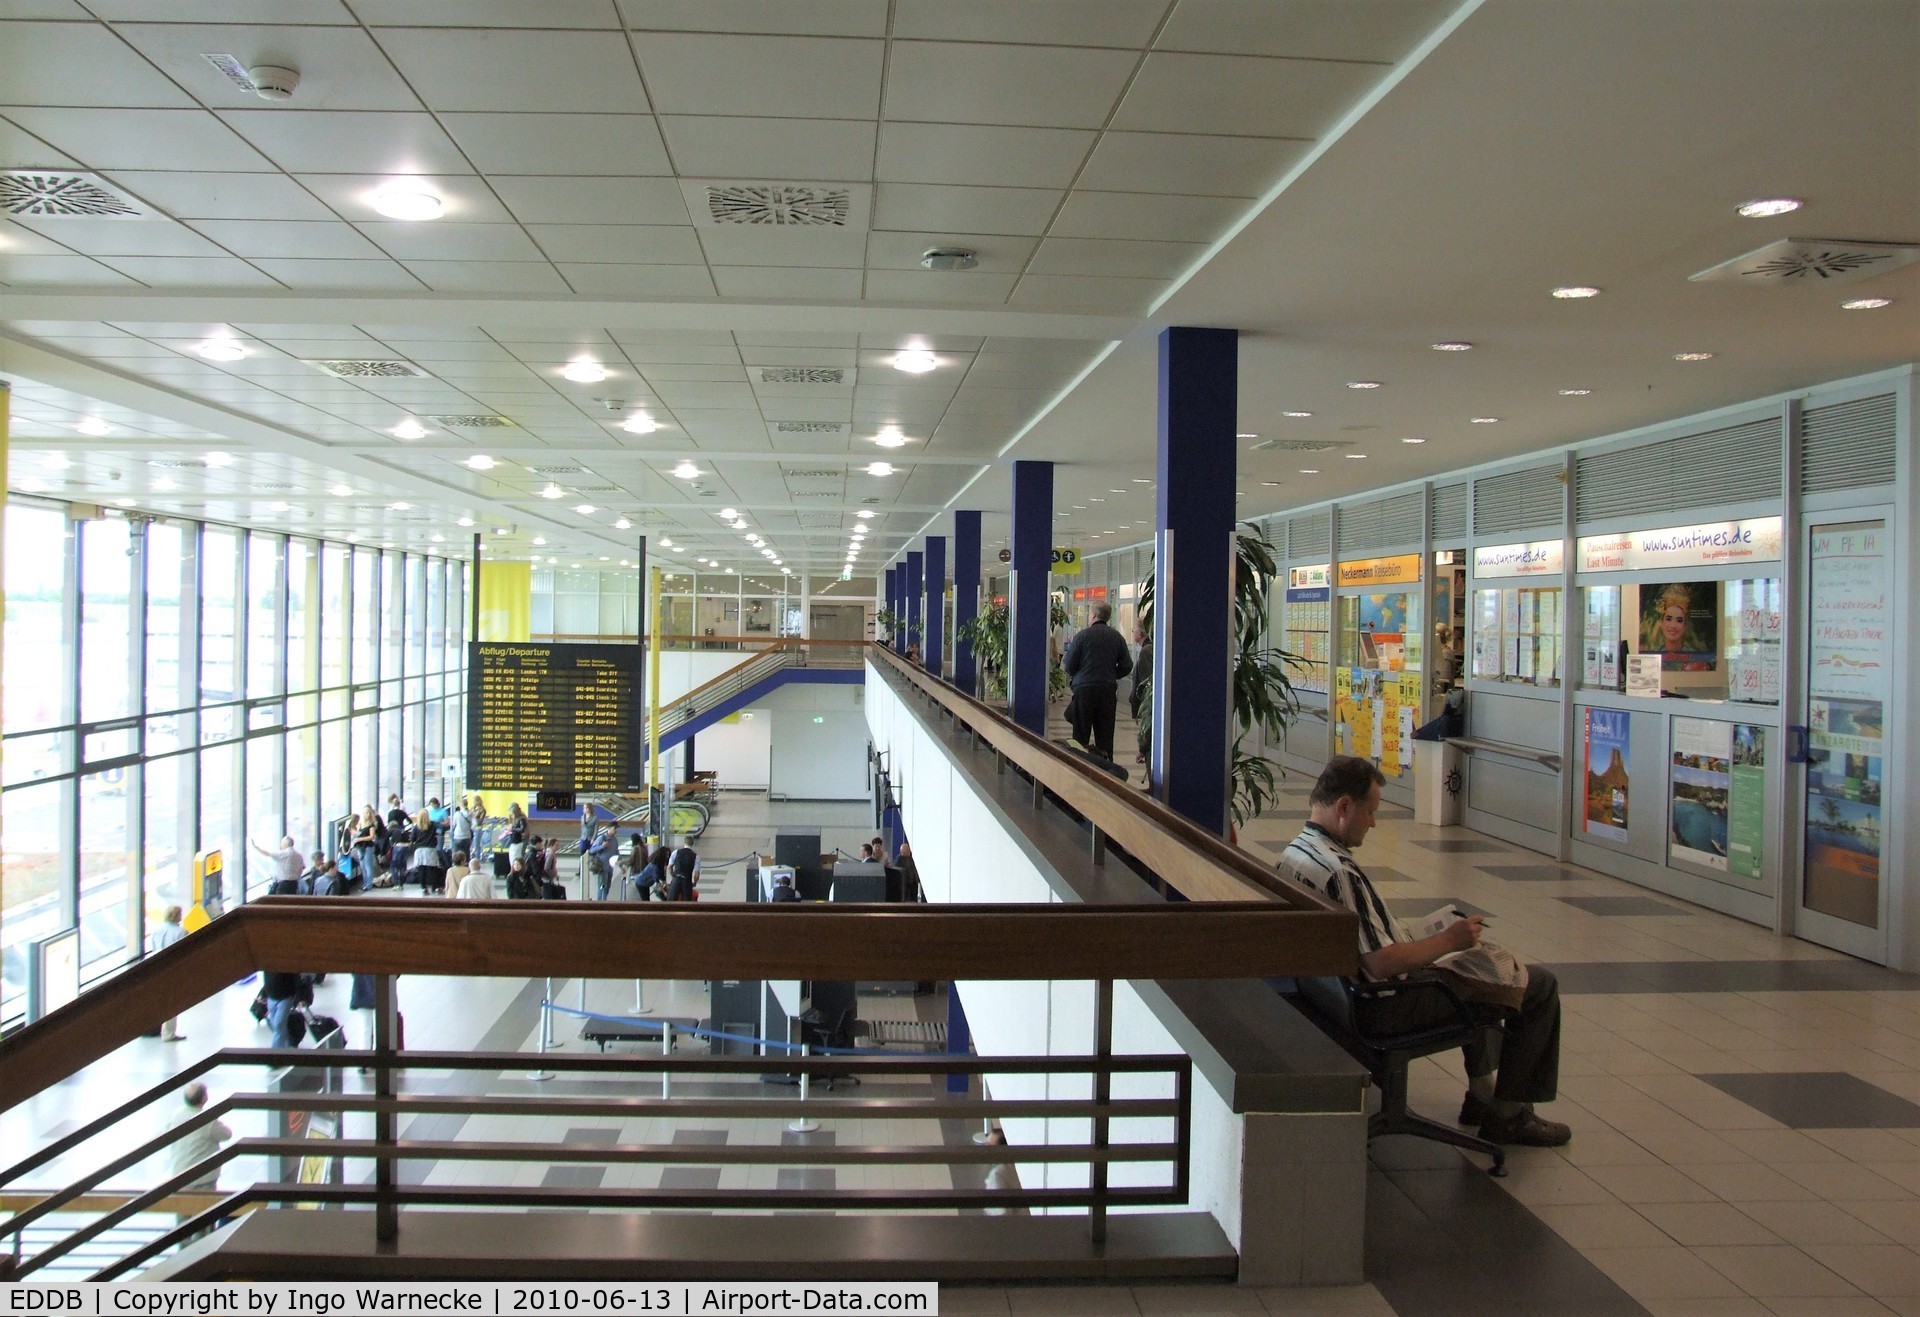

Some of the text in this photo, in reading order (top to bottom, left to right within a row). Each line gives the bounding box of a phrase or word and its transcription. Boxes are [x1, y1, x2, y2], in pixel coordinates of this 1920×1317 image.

[1643, 526, 1752, 552] www.suntimes.de
[1477, 547, 1547, 566] www.suntimes.de
[1587, 556, 1625, 568] Last Minute
[1341, 563, 1402, 580] Neckermann Reisebüro
[479, 647, 550, 657] Abflug/Departure
[1592, 723, 1611, 734] Freiheit
